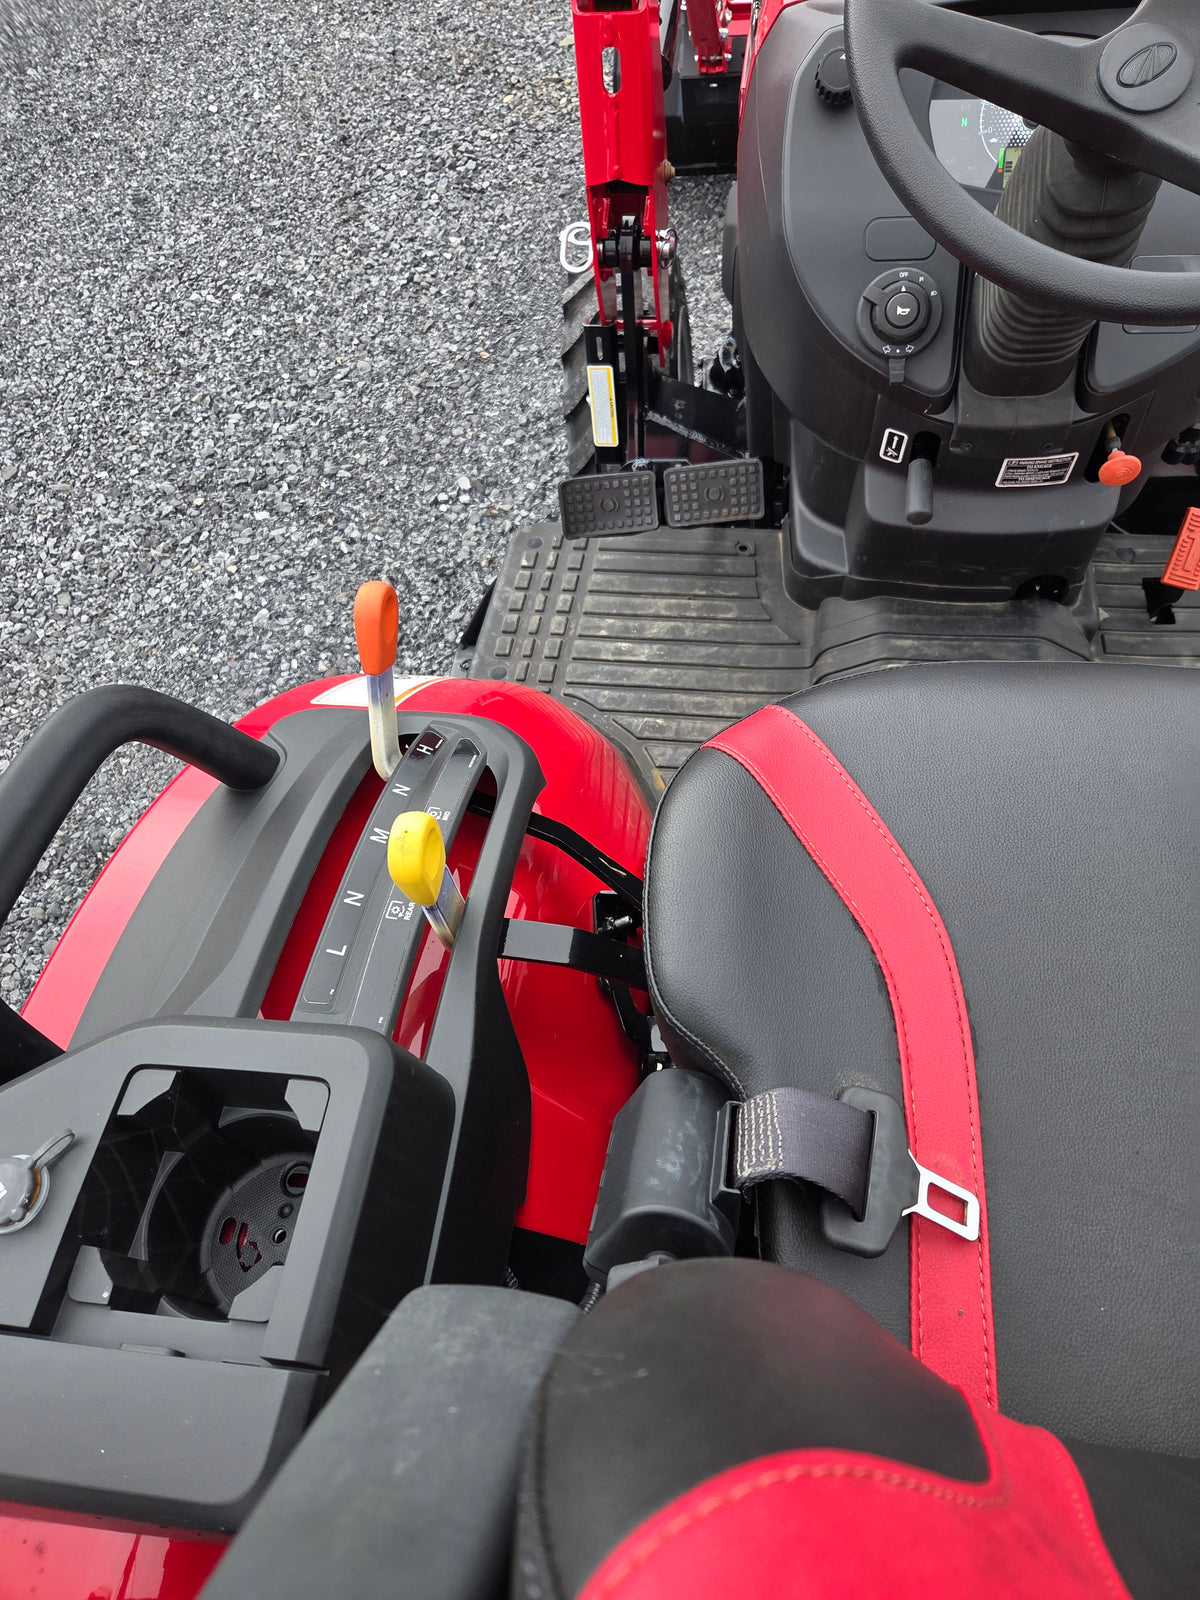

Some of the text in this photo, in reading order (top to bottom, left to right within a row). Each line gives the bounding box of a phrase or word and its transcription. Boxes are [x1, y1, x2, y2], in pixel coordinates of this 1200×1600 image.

[961, 118, 968, 127] N
[416, 744, 434, 755] H
[392, 783, 411, 797] N
[369, 827, 390, 844] M
[343, 890, 365, 907] N
[404, 902, 416, 920] REAR
[326, 945, 347, 956] L
